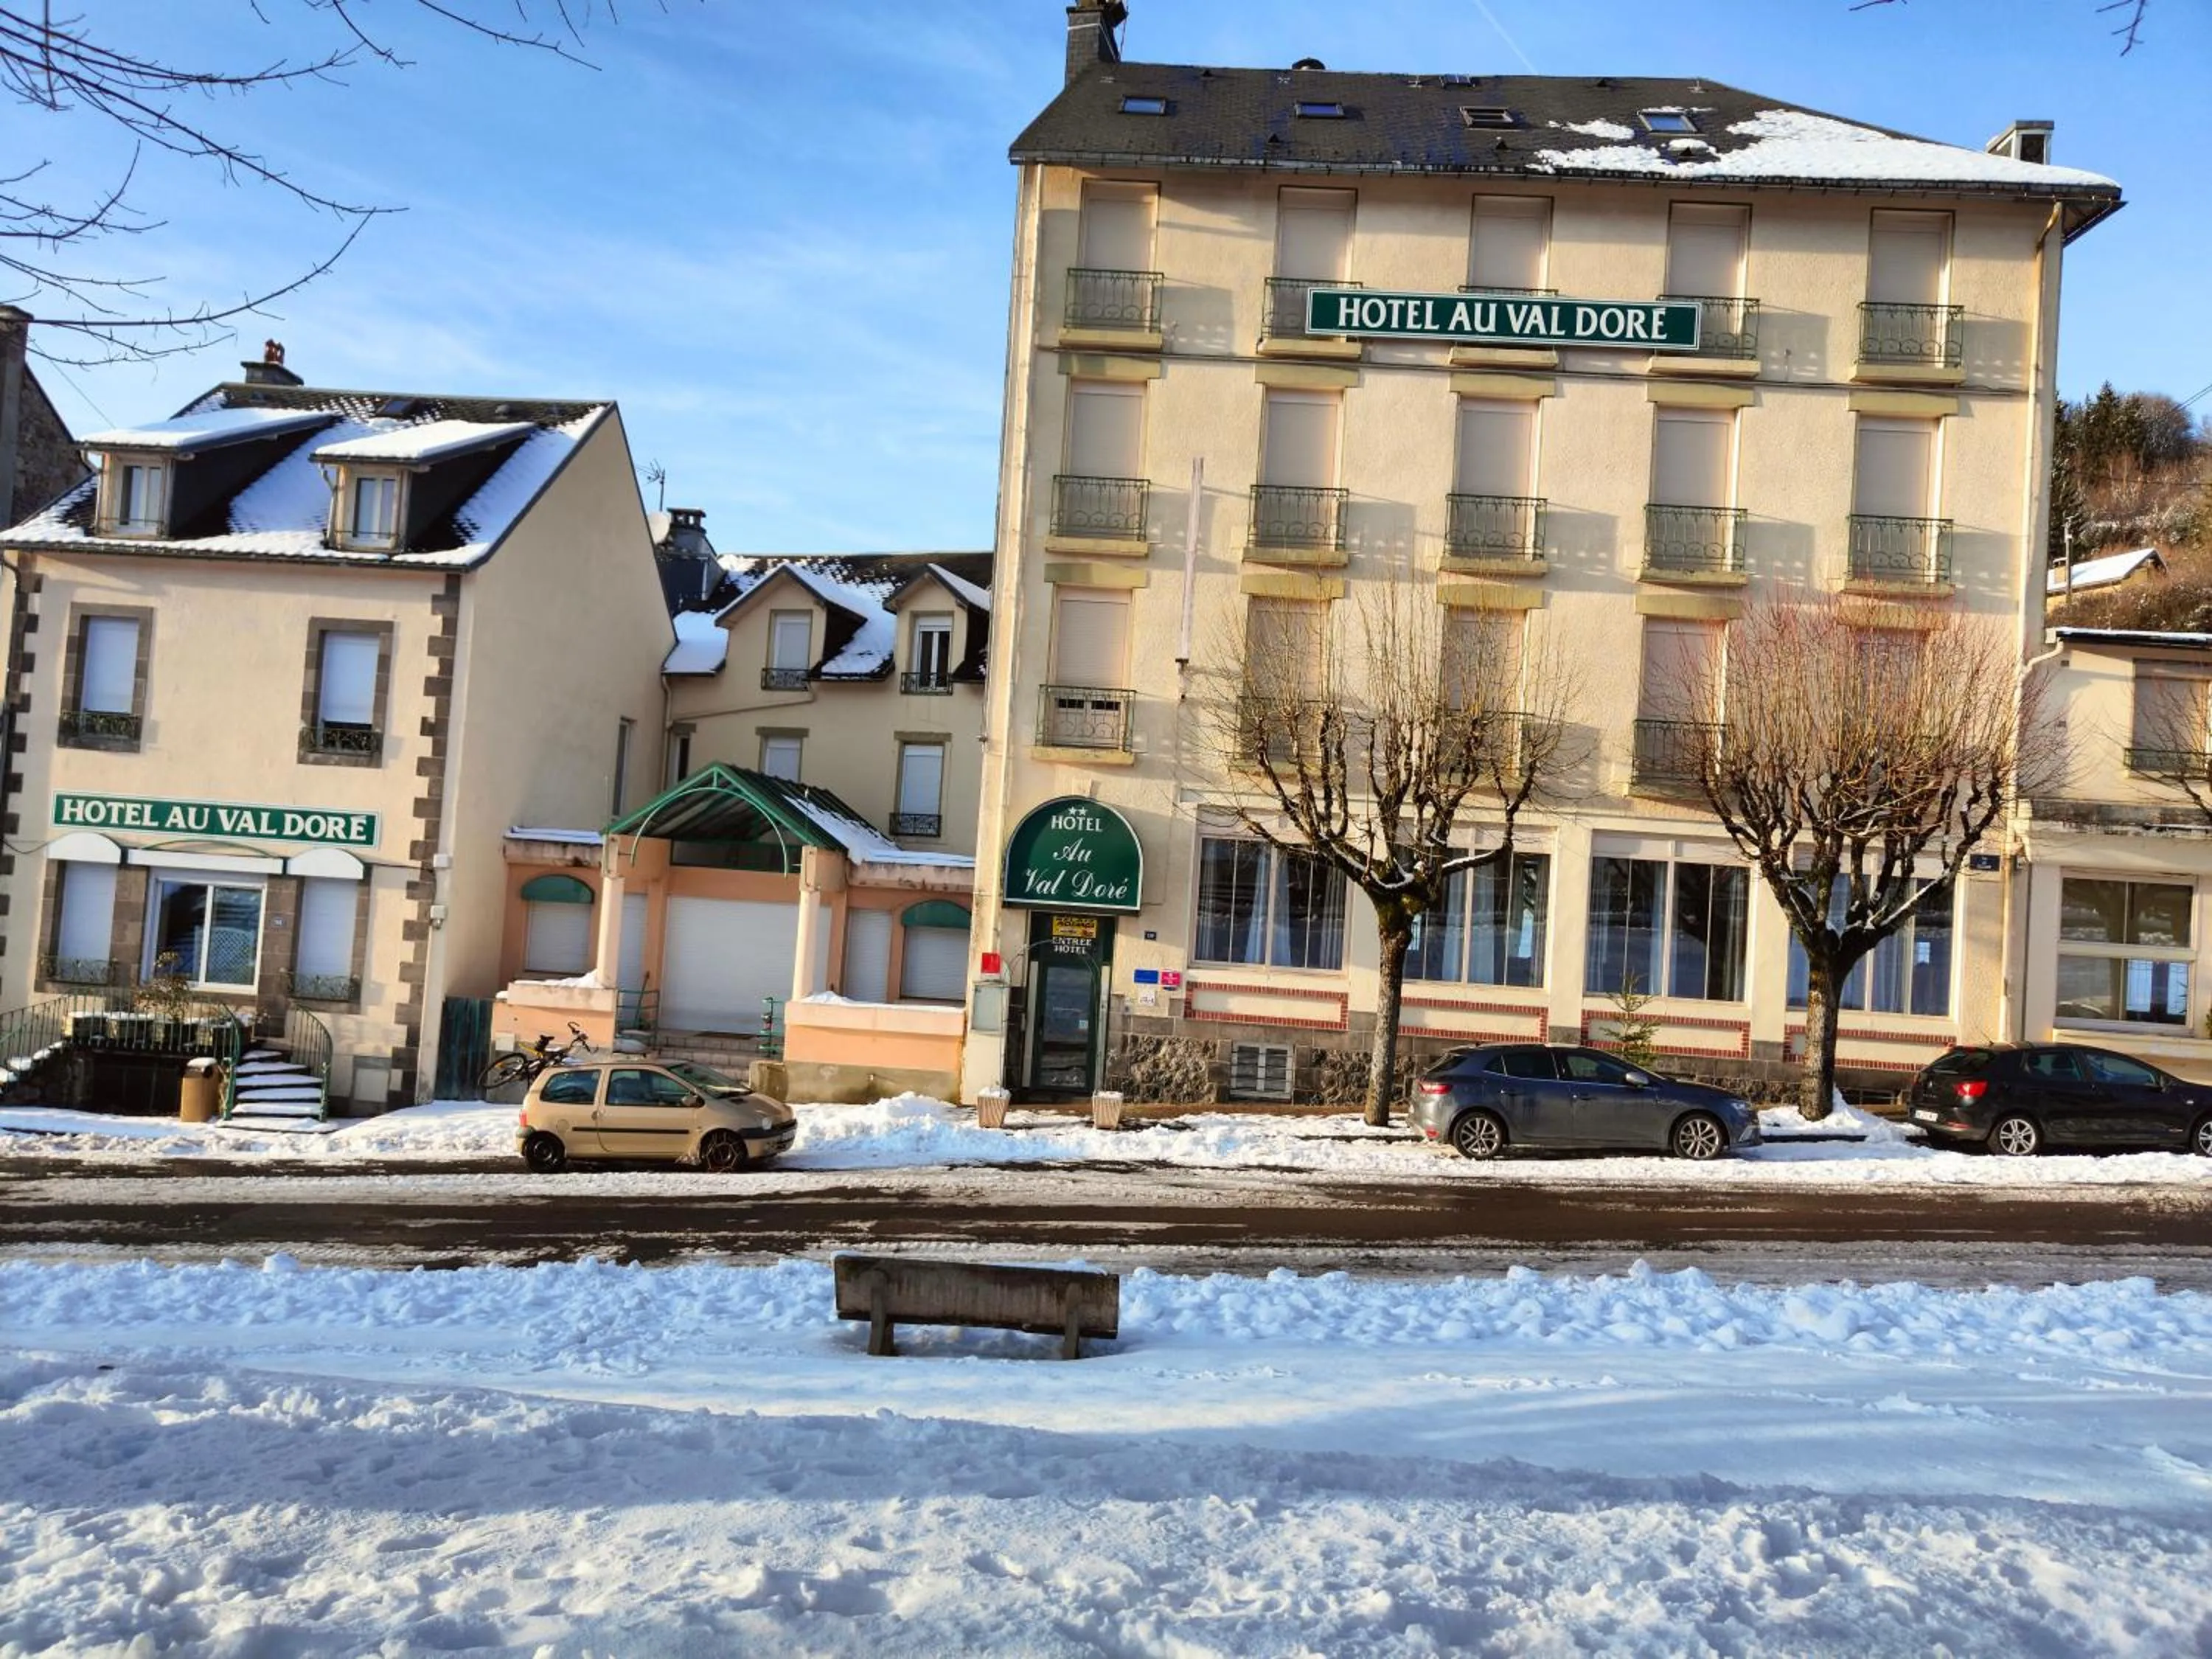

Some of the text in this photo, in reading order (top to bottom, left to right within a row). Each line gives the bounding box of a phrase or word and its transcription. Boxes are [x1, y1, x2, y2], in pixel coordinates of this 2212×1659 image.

[1338, 297, 1439, 330] HOTEL
[1447, 302, 1497, 333] AU
[1505, 304, 1567, 336] VAL
[61, 799, 159, 827] HOTEL
[164, 806, 210, 831] AU
[216, 810, 278, 835] VAL
[1051, 815, 1104, 832] HOTEL
[1052, 837, 1093, 863] Au
[1025, 867, 1130, 900] Val Doré
